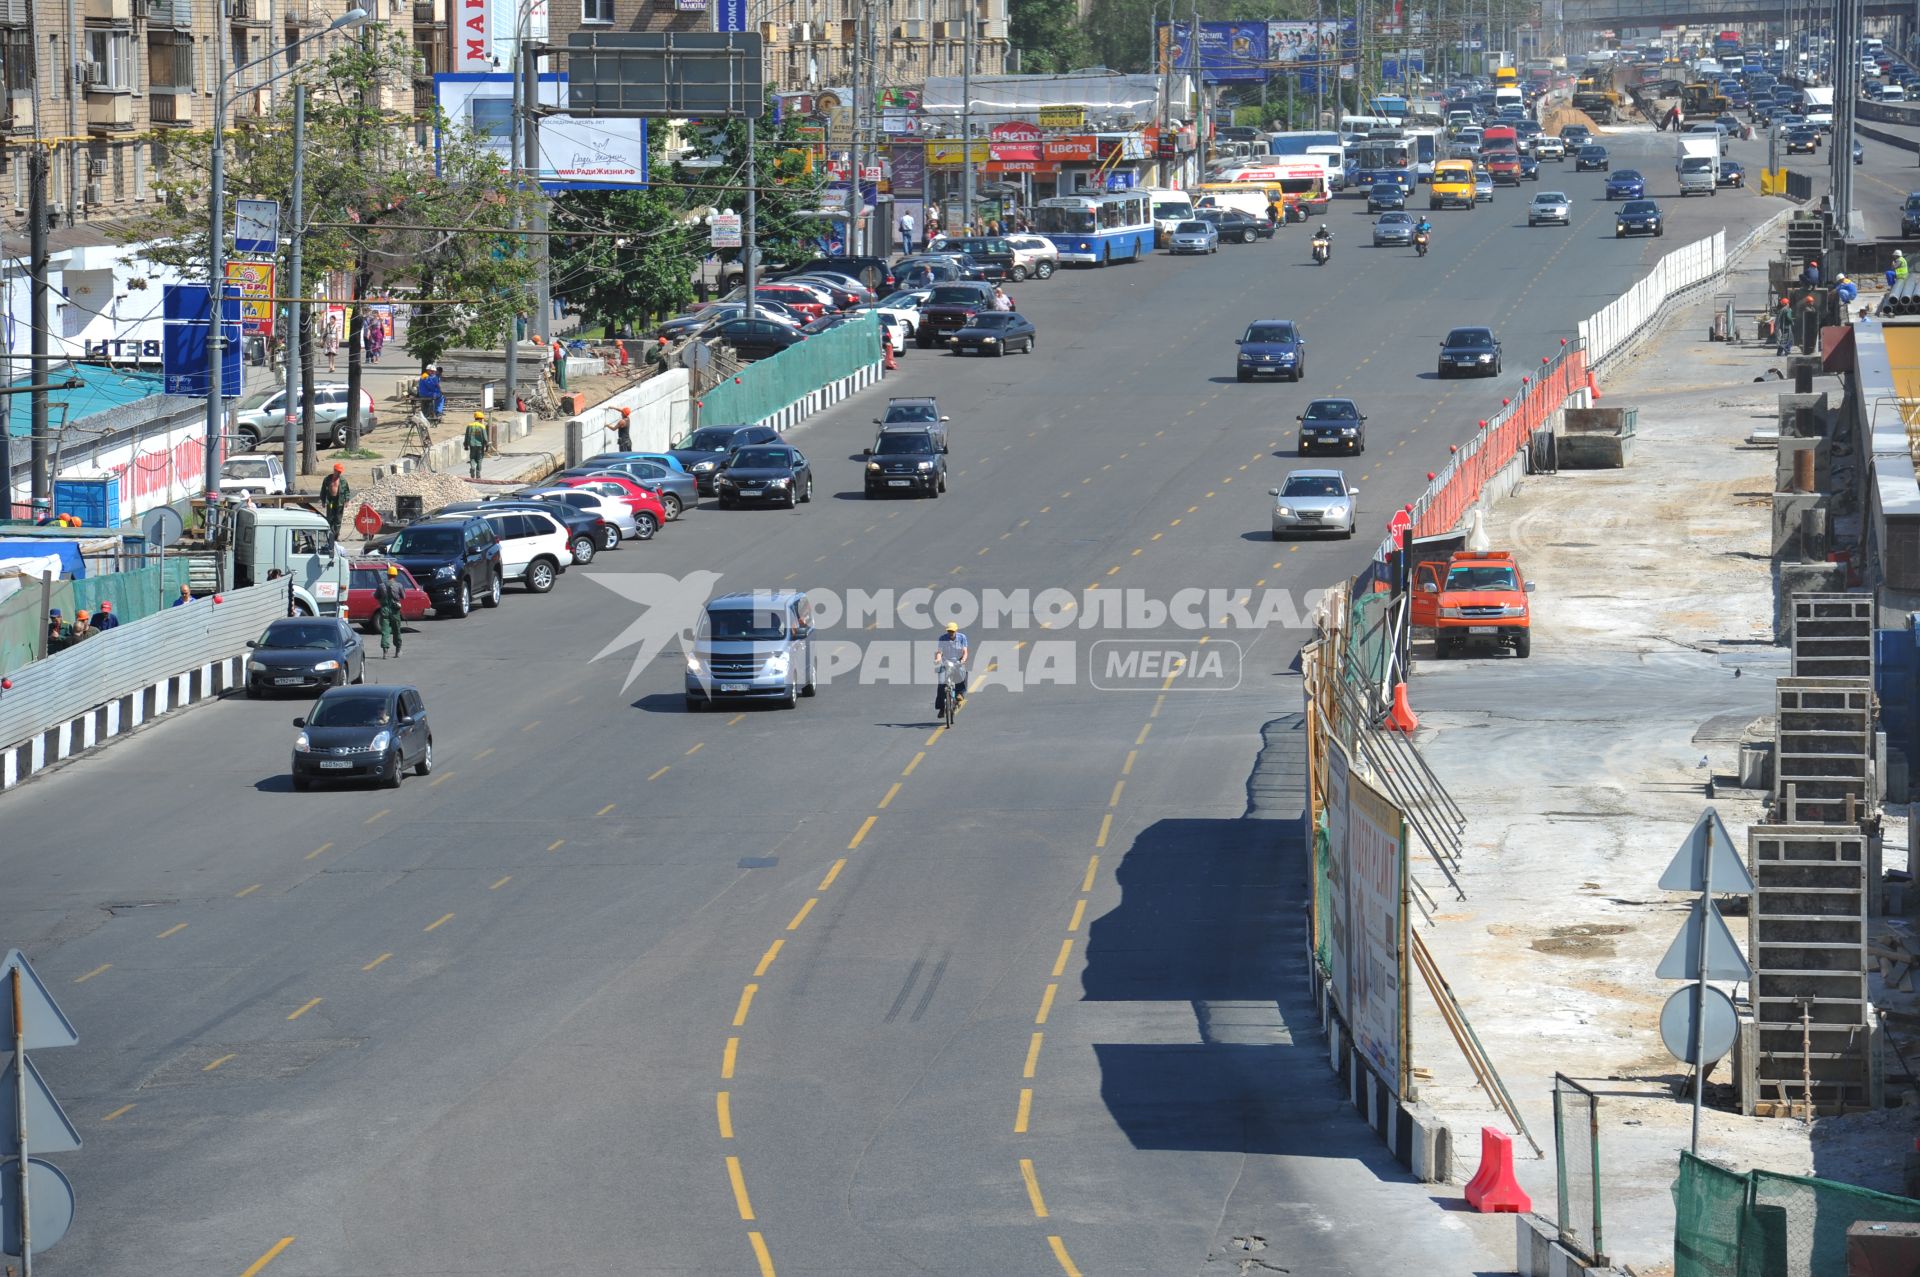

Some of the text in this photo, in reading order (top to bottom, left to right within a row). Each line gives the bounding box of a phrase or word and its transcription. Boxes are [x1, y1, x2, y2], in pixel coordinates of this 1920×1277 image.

[1049, 144, 1092, 154] цветы
[1003, 162, 1035, 171] цветы
[867, 169, 879, 177] 25
